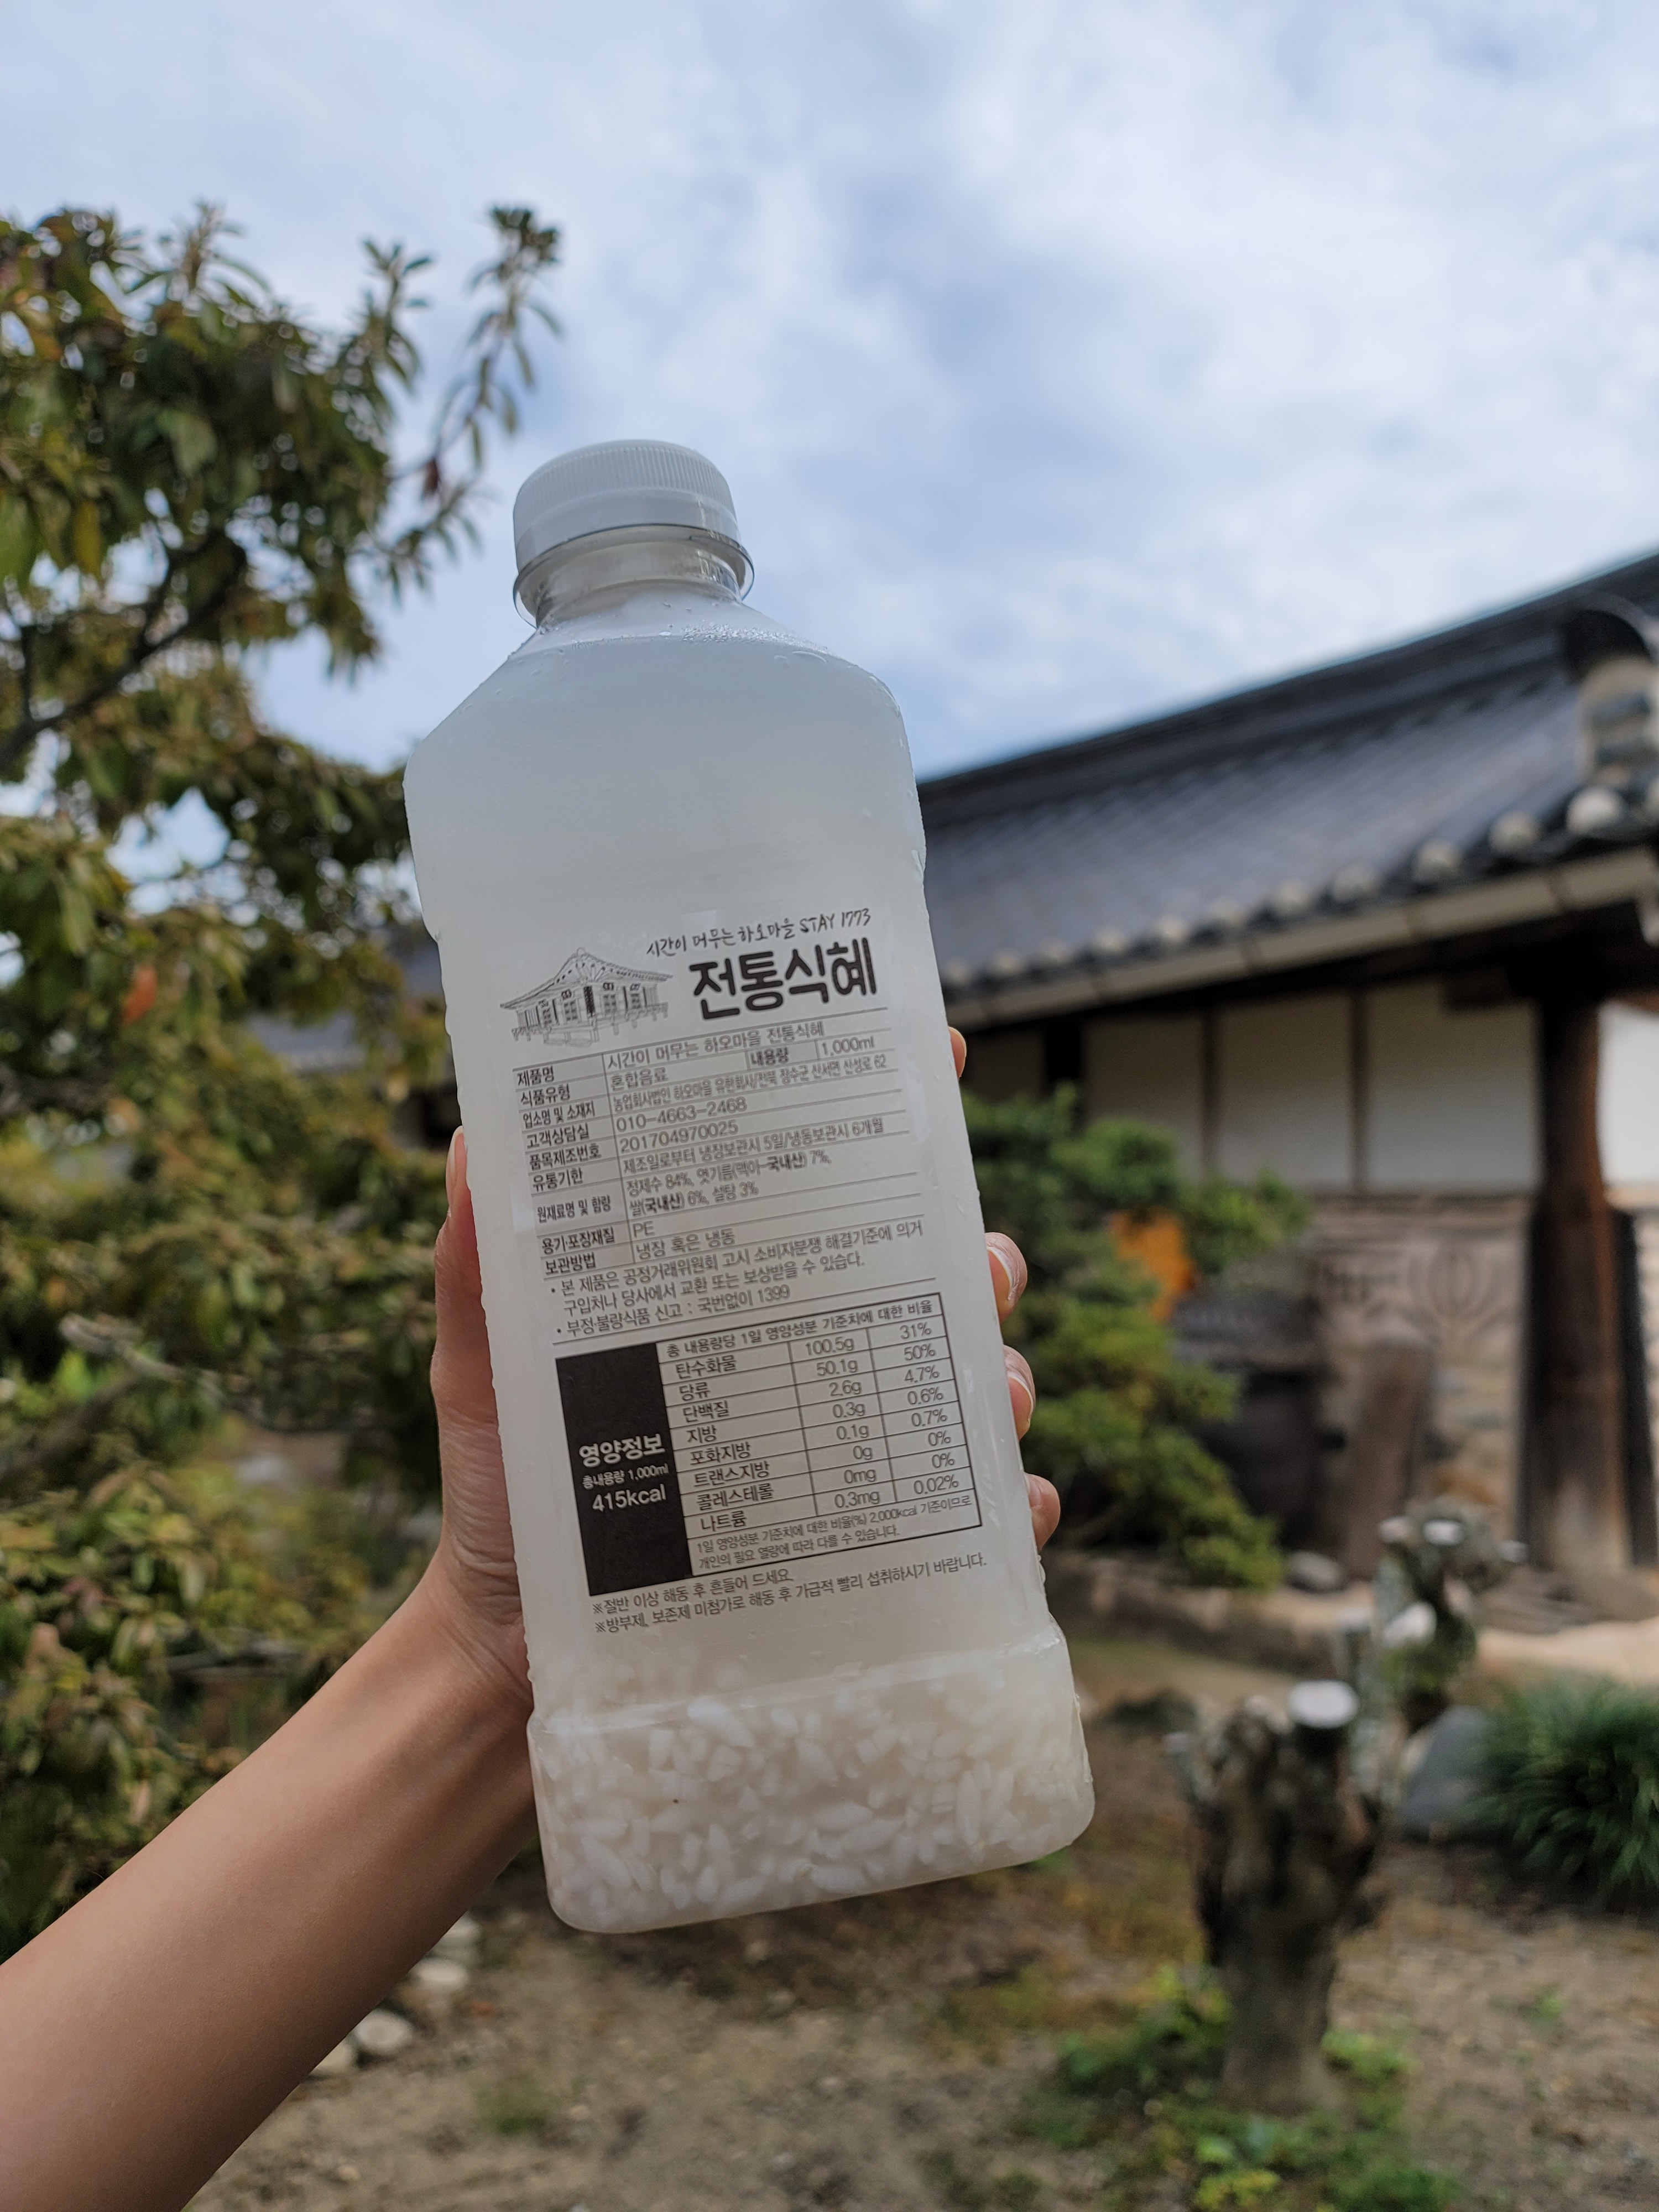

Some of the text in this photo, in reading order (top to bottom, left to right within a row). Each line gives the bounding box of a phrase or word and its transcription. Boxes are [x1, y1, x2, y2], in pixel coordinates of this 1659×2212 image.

[646, 907, 870, 957] 시간이 머무는 하오마을 STAY 1773
[688, 937, 877, 1020] 전통식혜
[608, 1021, 824, 1070] 시간이 머무는 하오마을 전통식혜
[750, 1047, 788, 1066] 내용량
[517, 1065, 554, 1086] 제품명
[611, 1067, 668, 1092] 혼합음료
[613, 1087, 673, 1114] 농업회사법인
[673, 1078, 714, 1100] 하오마을
[779, 1065, 810, 1086] 장수군
[811, 1061, 841, 1079] 산서면
[874, 1053, 886, 1069] 62
[520, 1083, 570, 1107] 식품유형
[523, 1100, 595, 1129] 업소명 및 소재지
[616, 1096, 747, 1132] 010-4663-2468
[526, 1122, 589, 1149] 고객상담실
[619, 1119, 738, 1153] 201704970025
[623, 1117, 883, 1173] 제조일로부터 냉장보관시 5일/냉동보관시 6개월
[529, 1142, 601, 1171] 품목제조번호
[533, 1167, 583, 1192] 유통기한
[626, 1176, 662, 1197] 정제수
[537, 1194, 611, 1223] 원재료명 및 함량
[629, 1192, 685, 1217] 쌀(국내산)
[712, 1183, 736, 1203] 설탕
[739, 1181, 759, 1197] 3%
[632, 1220, 654, 1238] PE
[636, 1228, 737, 1261] 냉장 혹은 냉동
[545, 1251, 596, 1275] 보관방법
[561, 1219, 923, 1297] 본 제품은 공정거래위원회 고시 소비자분쟁 해결기준에 의거
[564, 1292, 617, 1317] 구입처나
[621, 1281, 676, 1307] 당사에서
[680, 1276, 707, 1295] 교환
[711, 1272, 739, 1290] 또는
[743, 1261, 797, 1285] 보상받을
[801, 1259, 816, 1275] 수
[654, 1303, 683, 1322] 신고
[697, 1290, 753, 1313] 국번없이
[757, 1284, 790, 1302] 1399
[666, 1300, 932, 1358] 총 내용량당 1일 영양성분 기준치에 대한 비율
[899, 1322, 932, 1339] 31%
[805, 1336, 854, 1355] 100.5g
[904, 1343, 936, 1361] 50%
[675, 1354, 736, 1379] 탄수화물
[816, 1359, 858, 1376] 50.1g
[904, 1365, 940, 1383] 4.7%
[679, 1381, 711, 1401] 당류
[828, 1379, 862, 1396] 2.6g
[907, 1386, 943, 1405] 0.6%
[682, 1400, 729, 1423] 단백질
[832, 1401, 865, 1418] 0.3g
[911, 1408, 947, 1427] 0.7%
[686, 1425, 717, 1443] 지방
[836, 1423, 869, 1440] 0.1g
[927, 1430, 951, 1446] 0%
[579, 1433, 665, 1467] 영양정보
[690, 1441, 750, 1465] 포화지방
[852, 1445, 873, 1460] 0g
[931, 1452, 955, 1468] 0%
[582, 1463, 668, 1489] 총내용량 1,000ml
[693, 1460, 769, 1487] 트랜스지방
[843, 1469, 877, 1484] 0mg
[913, 1474, 958, 1494] 0.02%
[592, 1484, 665, 1511] 415kcal
[696, 1483, 774, 1511] 콜레스테롤
[834, 1491, 880, 1508] 0.3mg
[697, 1539, 713, 1553] 1일
[716, 1532, 759, 1551] 영양성분
[761, 1524, 804, 1541] 기준치에
[806, 1520, 828, 1533] 대한
[830, 1512, 867, 1529] 비율(%)
[920, 1495, 972, 1514] 기준이므로
[700, 1510, 747, 1531] 나트륨
[698, 1524, 900, 1569] 개인의 필요 열량에 따라 다를 수 있습니다.
[633, 1590, 659, 1608] 이상
[662, 1585, 689, 1602] 해동
[692, 1582, 706, 1598] 후
[709, 1574, 748, 1595] 흔들어
[652, 1604, 691, 1624] 보존제
[693, 1595, 746, 1616] 미첨가로
[748, 1589, 775, 1606] 해동
[778, 1586, 792, 1601] 후
[795, 1578, 834, 1598] 가급적
[836, 1573, 863, 1592] 빨리
[867, 1562, 930, 1587] 섭취하시기
[933, 1552, 987, 1574] 바랍니다.
